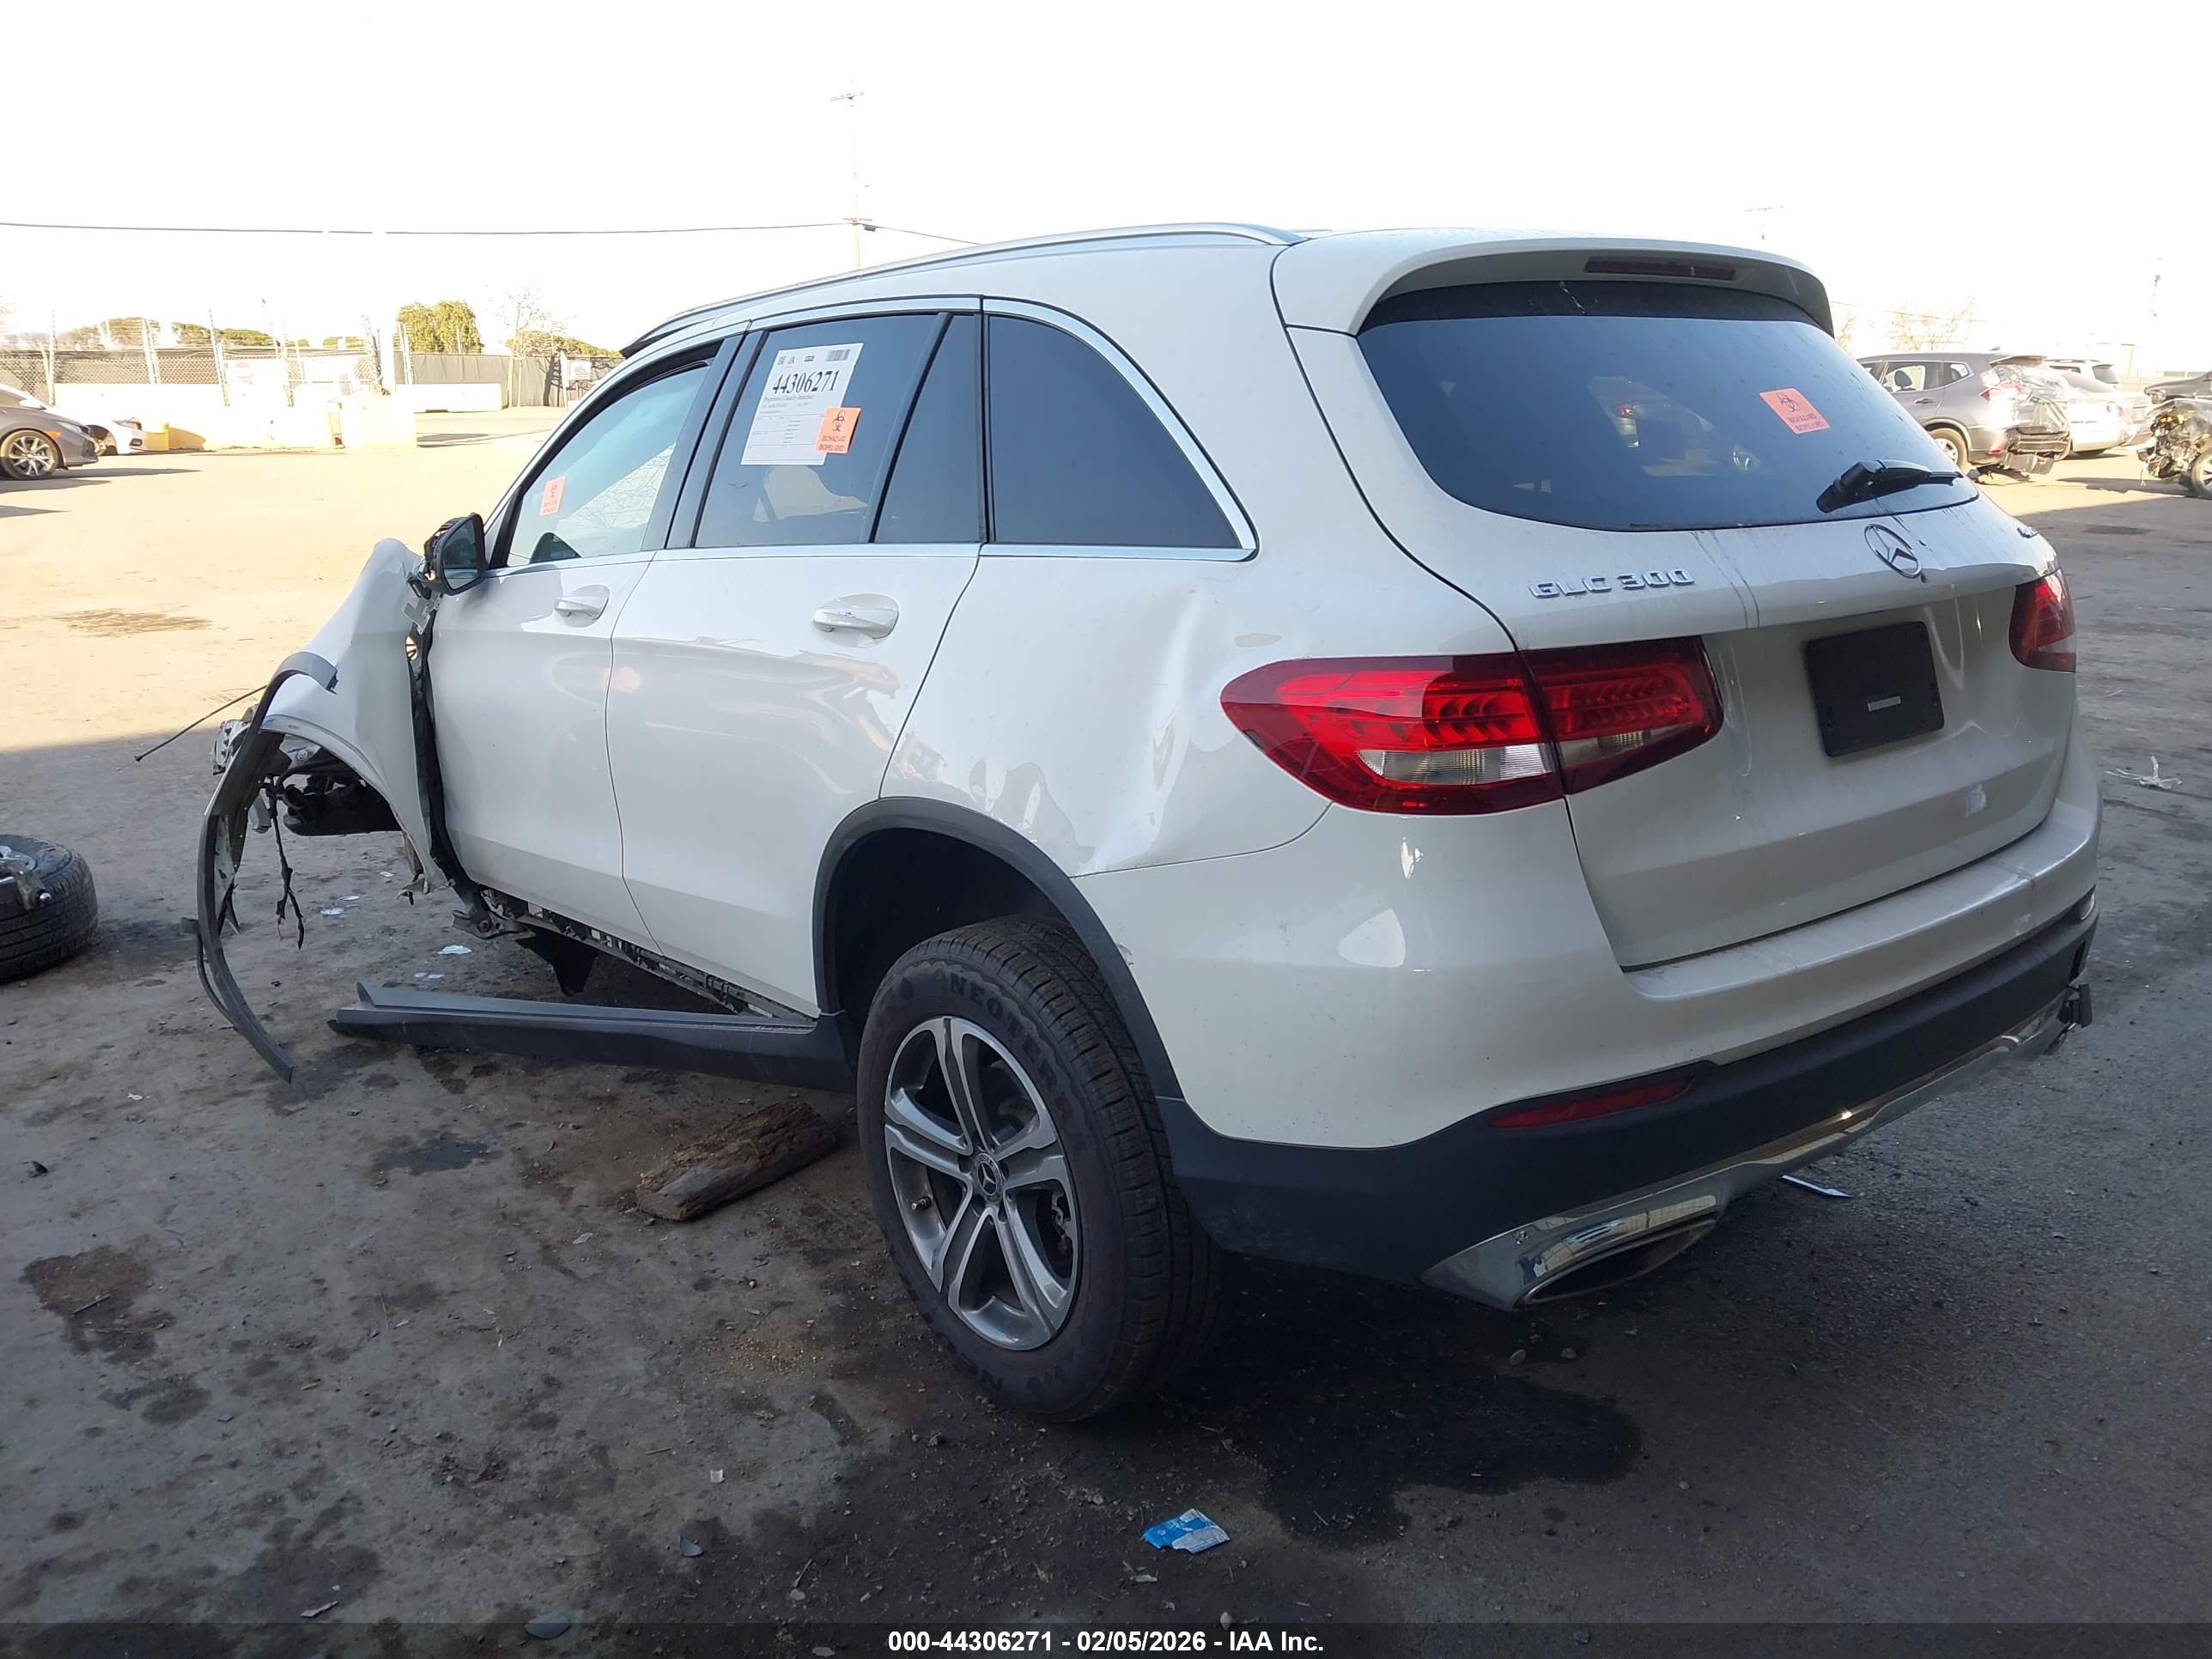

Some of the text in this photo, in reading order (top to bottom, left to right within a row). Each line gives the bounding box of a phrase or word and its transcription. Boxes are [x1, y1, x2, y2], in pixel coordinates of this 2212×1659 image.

[772, 369, 840, 395] 44306271
[1528, 568, 1695, 599] GLC 300
